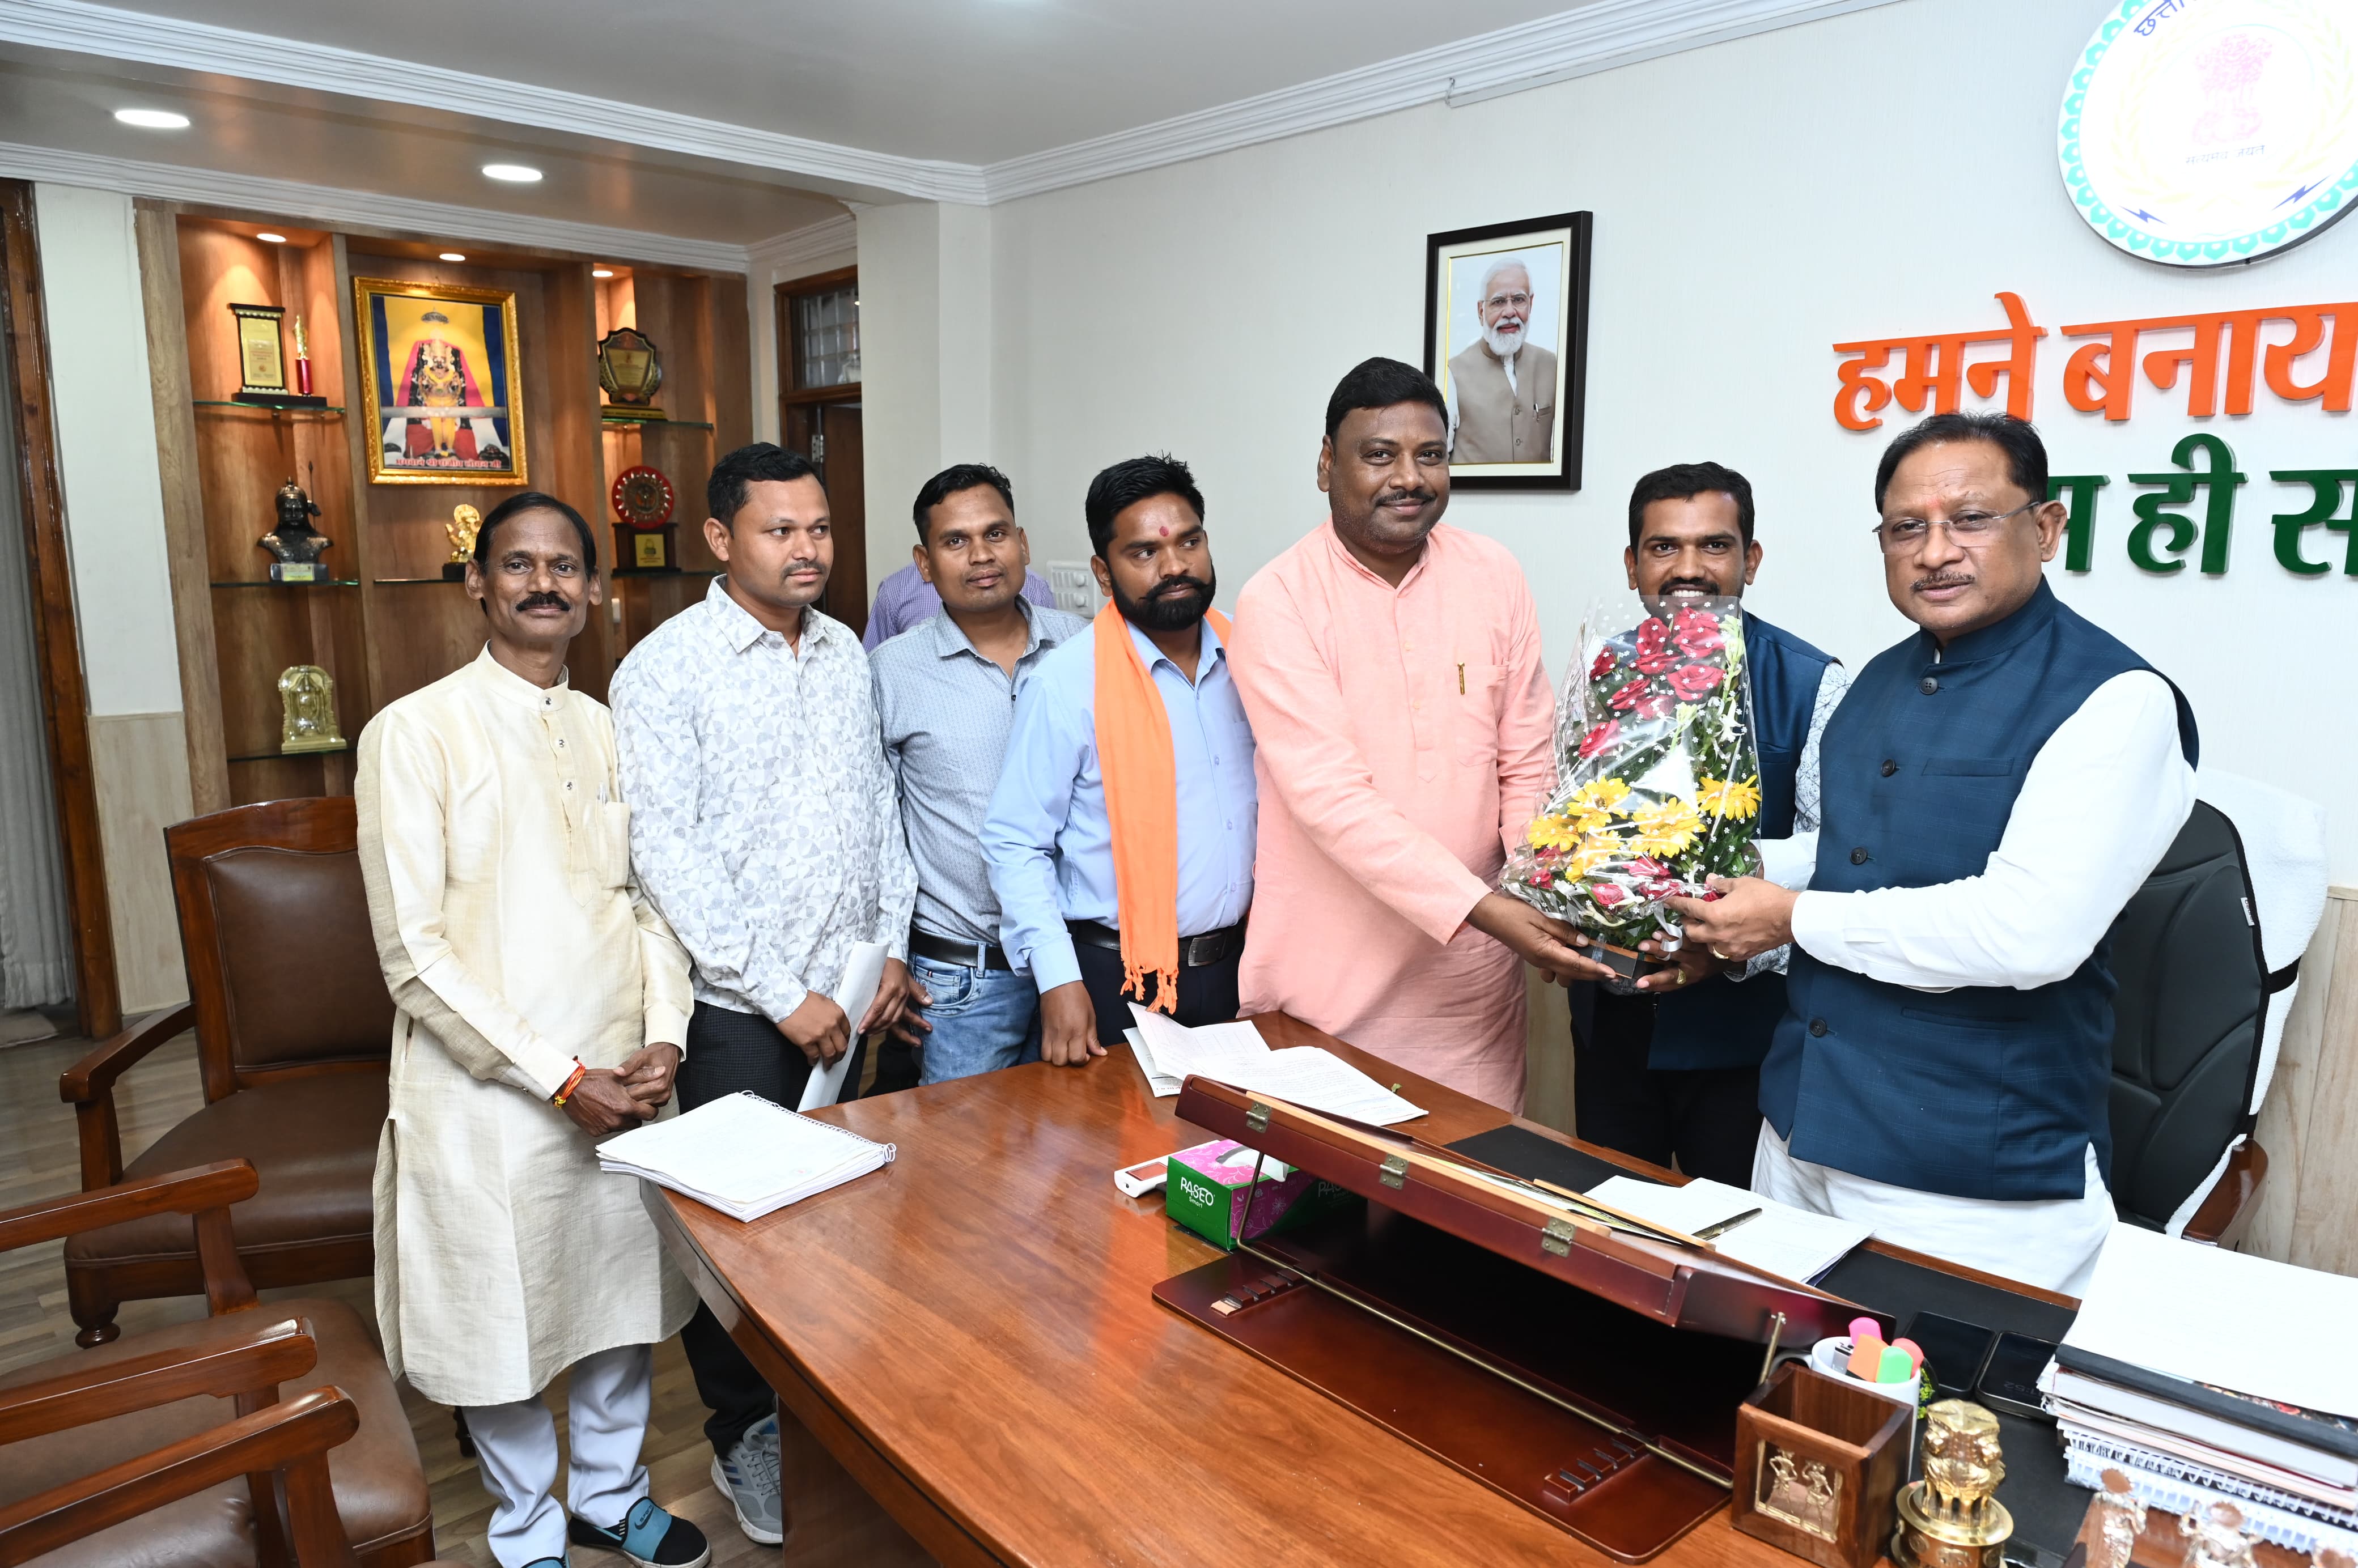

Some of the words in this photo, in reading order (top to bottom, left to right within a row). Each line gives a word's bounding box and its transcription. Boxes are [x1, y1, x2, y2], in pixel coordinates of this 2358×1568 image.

[1832, 291, 2049, 431] हमने
[2060, 302, 2358, 421] बनाय
[2127, 432, 2248, 575] ही
[1181, 1176, 1214, 1206] PASEO
[1189, 1196, 1203, 1208] Smart
